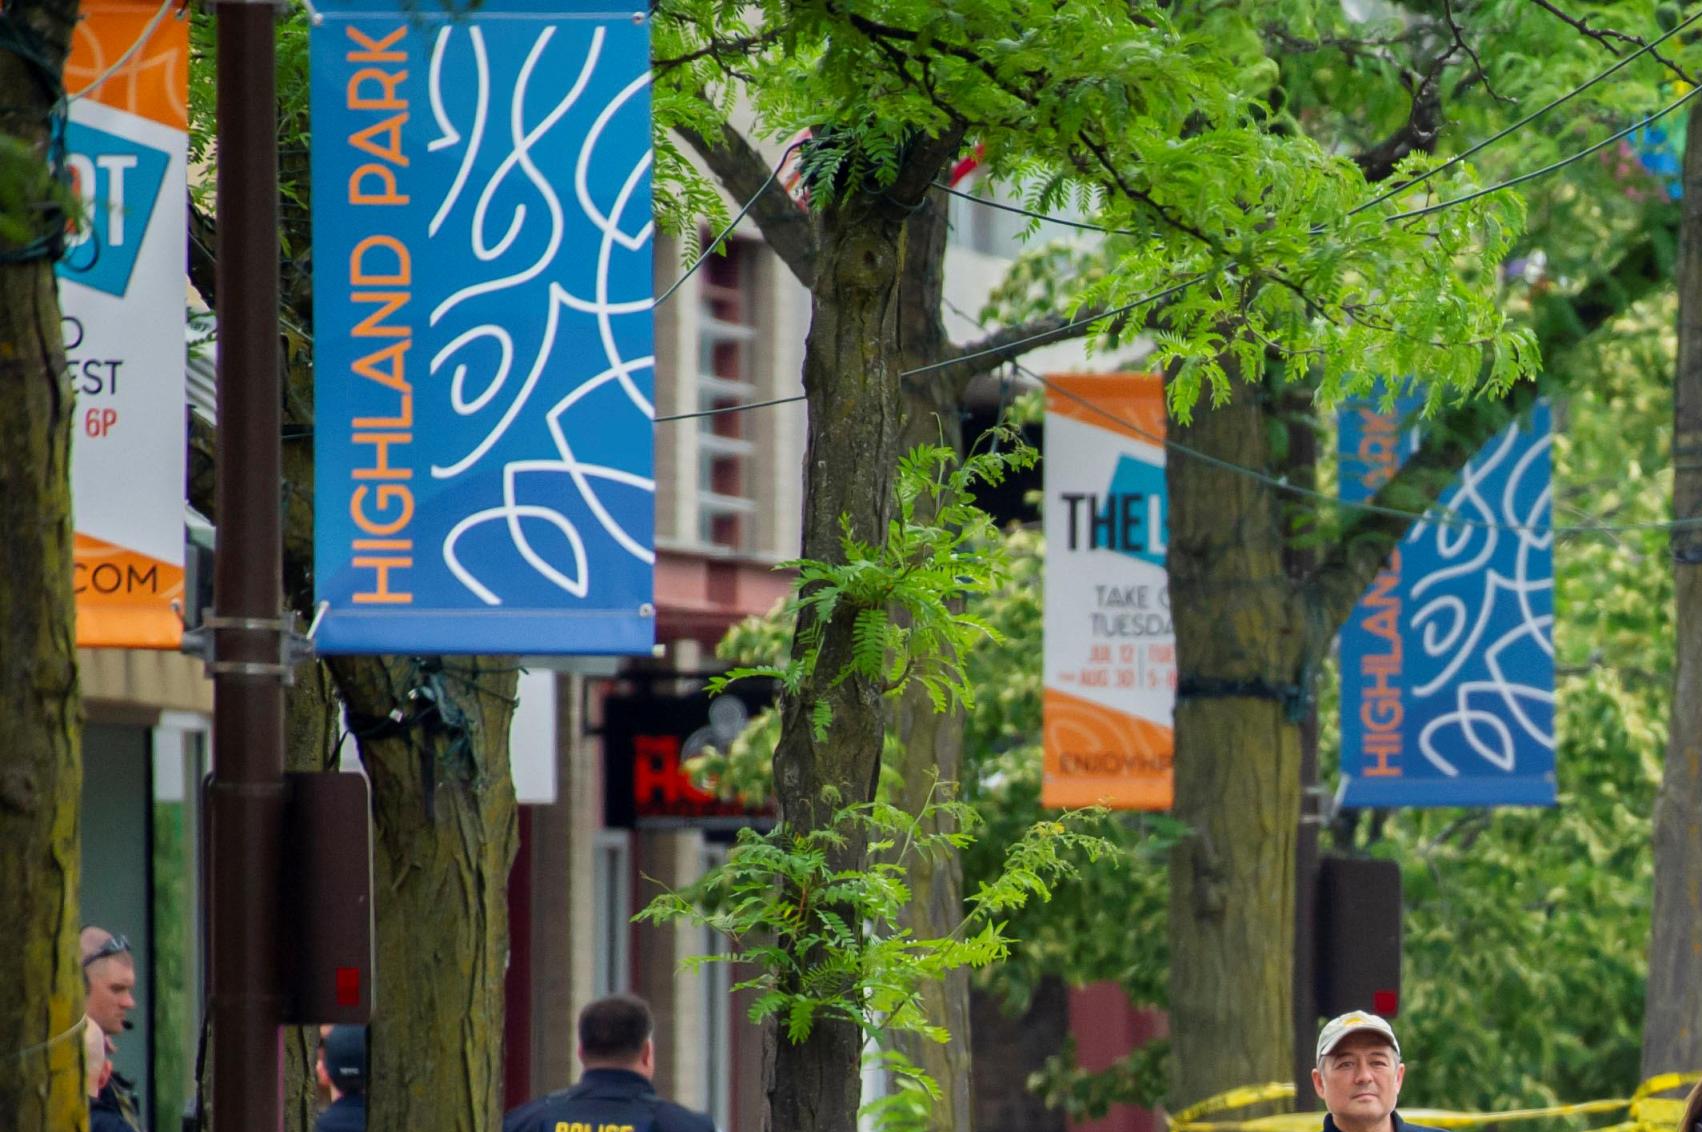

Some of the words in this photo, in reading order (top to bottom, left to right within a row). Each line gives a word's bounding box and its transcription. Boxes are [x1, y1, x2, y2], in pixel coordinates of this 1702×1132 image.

[345, 25, 410, 205] PARK
[64, 154, 138, 246] OT
[66, 359, 123, 395] EST
[349, 233, 415, 605] HIGHLAND
[1358, 407, 1400, 504] ARK
[74, 563, 157, 593] COM
[1095, 585, 1149, 609] TAKE
